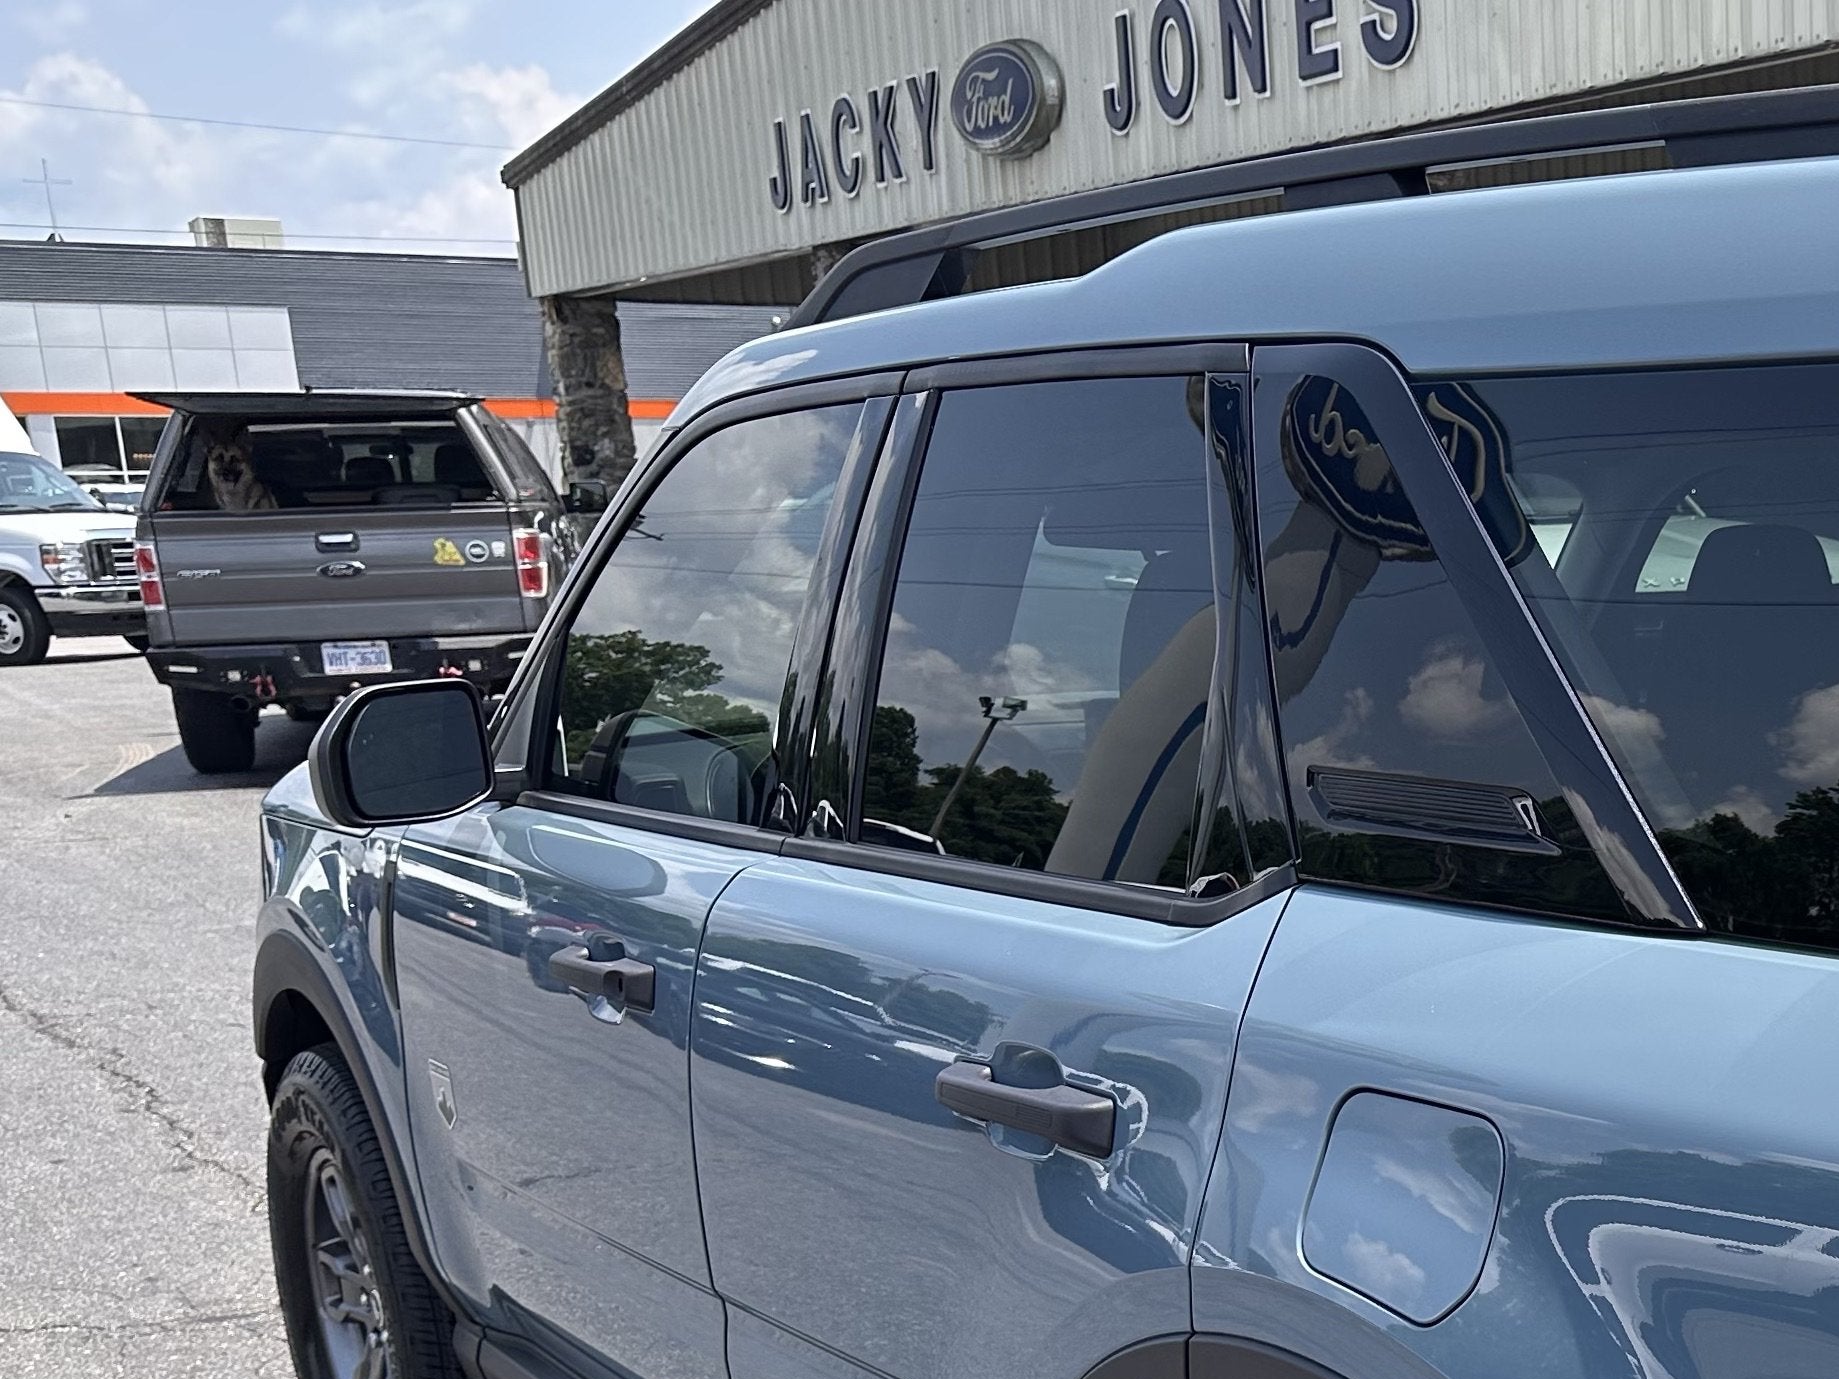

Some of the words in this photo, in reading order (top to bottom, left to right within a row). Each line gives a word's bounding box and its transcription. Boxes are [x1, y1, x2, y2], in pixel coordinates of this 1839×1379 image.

[769, 66, 940, 215] JACKY
[1102, 0, 1420, 136] JONES
[963, 67, 1014, 132] Ford
